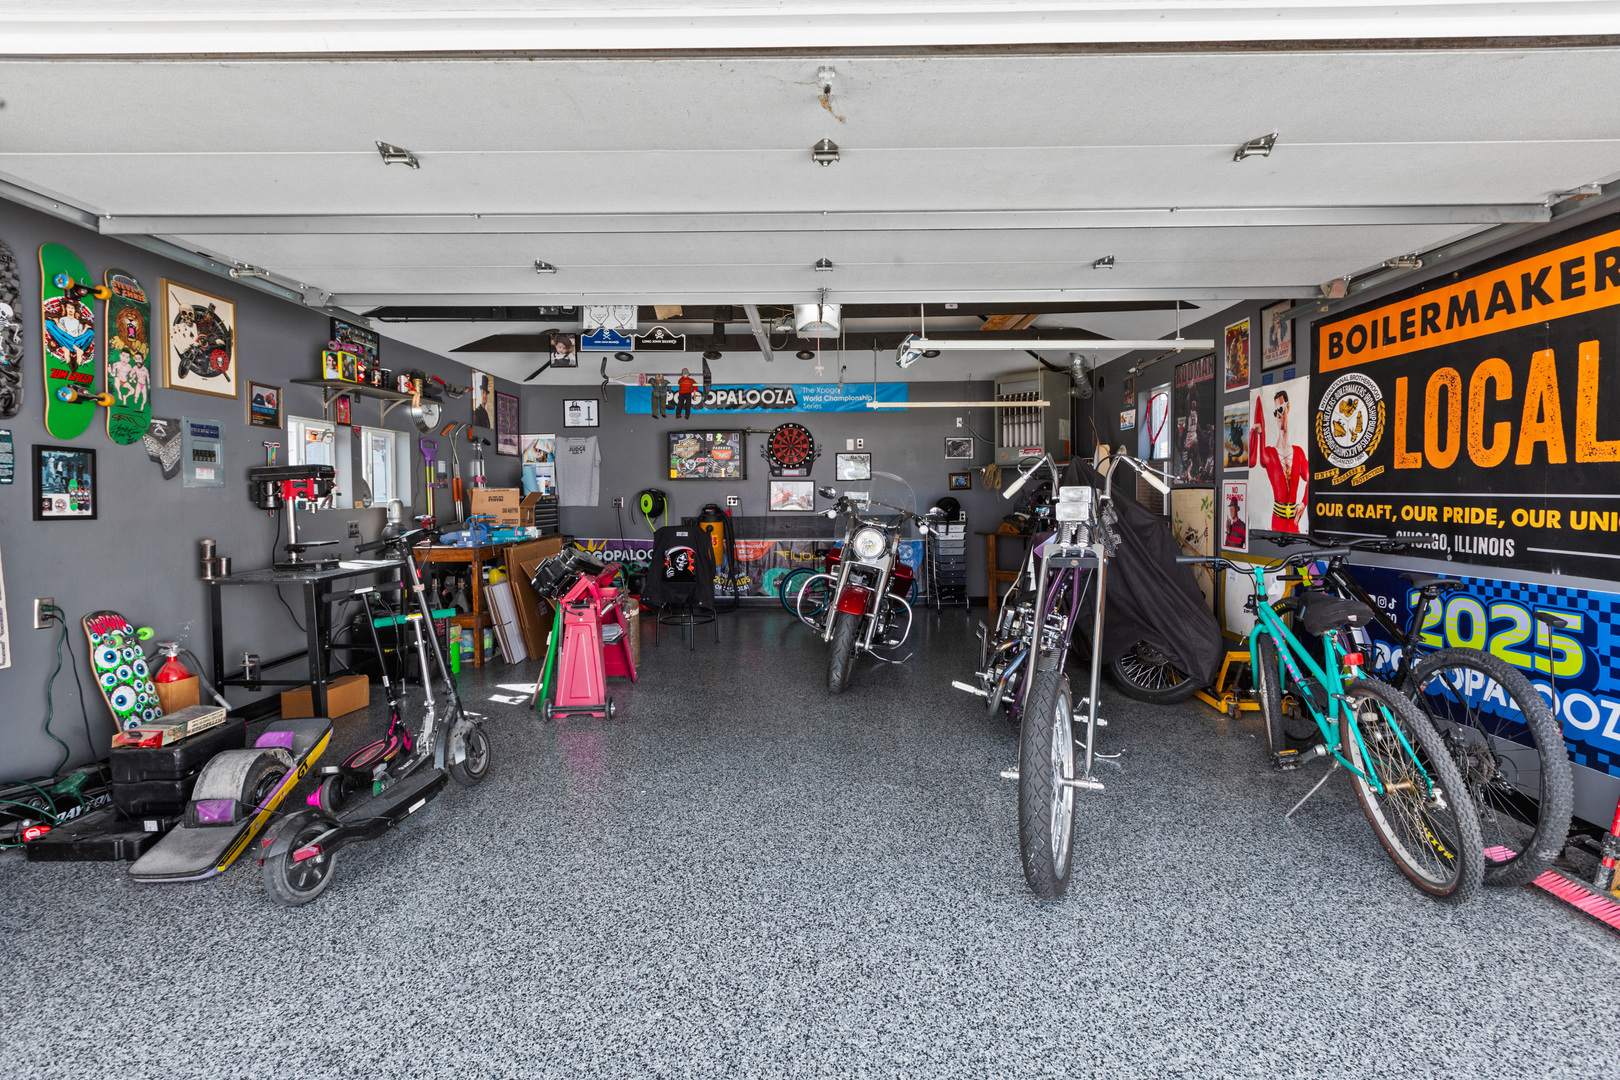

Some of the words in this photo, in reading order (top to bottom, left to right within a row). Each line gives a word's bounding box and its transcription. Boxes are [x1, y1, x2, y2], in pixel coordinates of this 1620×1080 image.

[67, 371, 94, 384] GREEN
[824, 394, 873, 403] Championship
[1393, 339, 1620, 470] LOCAL
[1231, 486, 1239, 494] NO
[1316, 502, 1343, 517] OUR
[1347, 503, 1397, 522] CRAFT,
[1401, 505, 1438, 522] OUR
[1443, 506, 1505, 529] PRIDE,
[1511, 508, 1561, 529] OUR
[1569, 510, 1620, 532] UNI
[1454, 535, 1515, 558] ILLINOIS
[87, 614, 127, 637] HEROIN
[1411, 592, 1583, 677] 2025
[297, 759, 308, 780] GT
